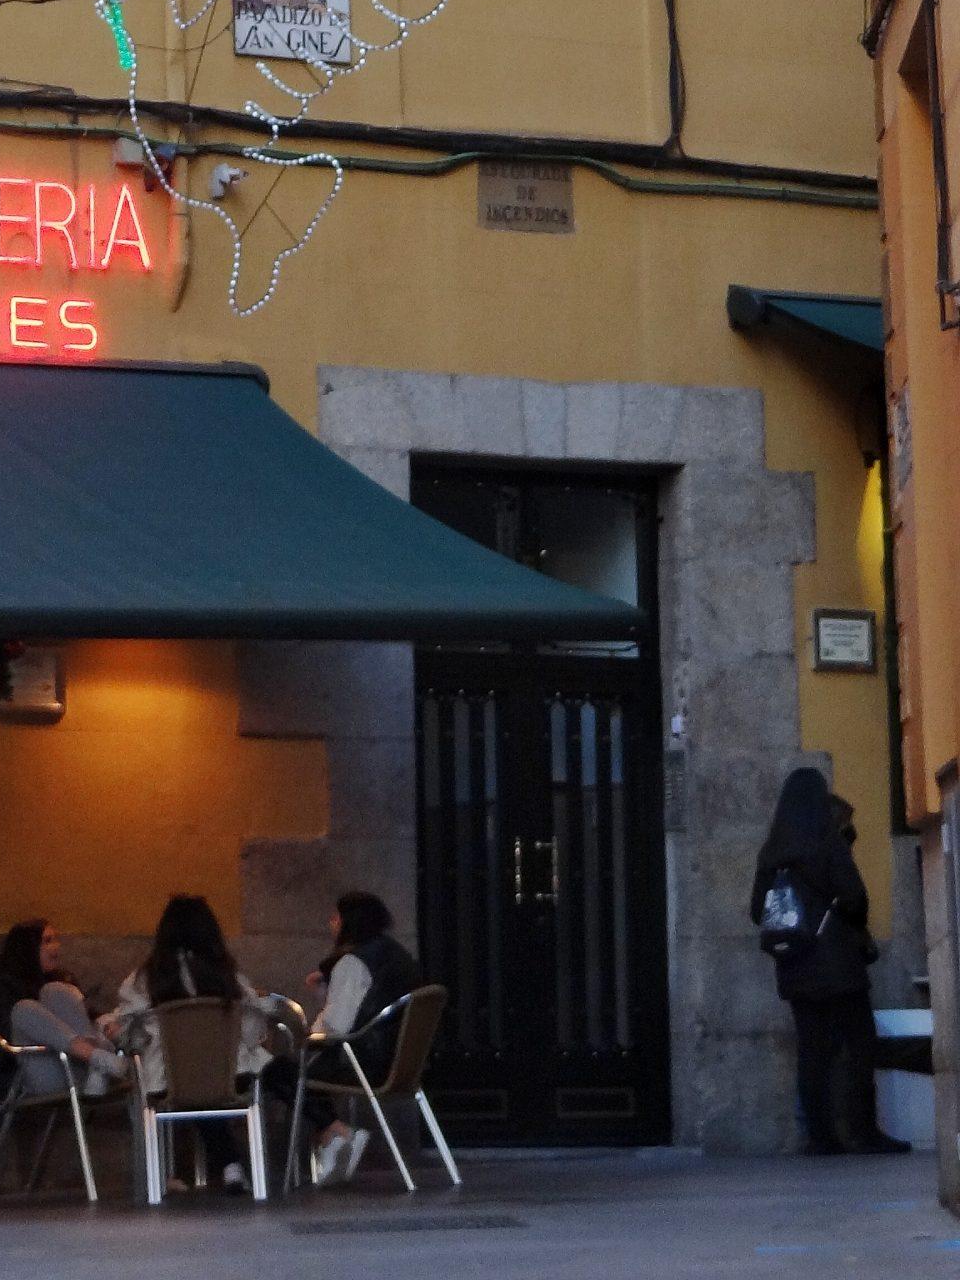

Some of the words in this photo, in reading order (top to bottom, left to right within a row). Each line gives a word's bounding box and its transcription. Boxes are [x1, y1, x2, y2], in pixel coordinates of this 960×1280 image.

[236, 0, 323, 26] PASADIZO
[237, 24, 275, 50] SAN
[286, 27, 350, 58] GINES
